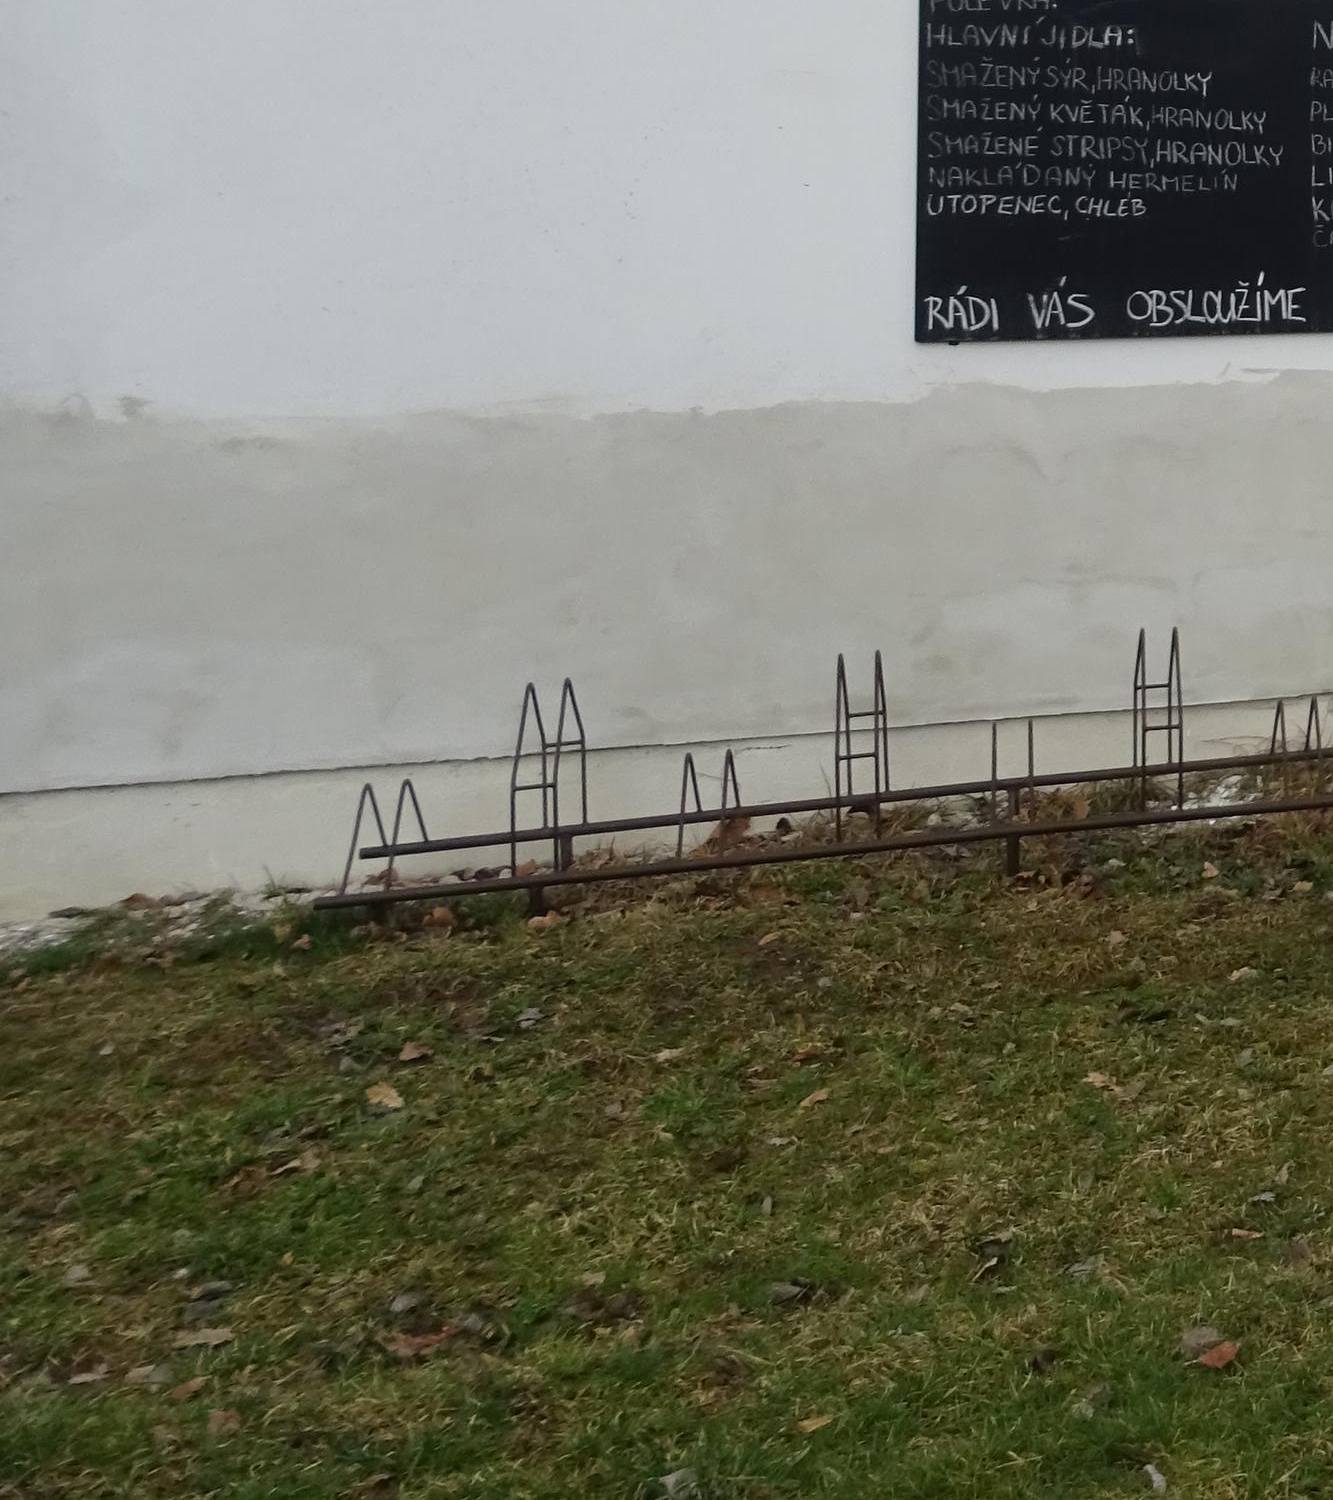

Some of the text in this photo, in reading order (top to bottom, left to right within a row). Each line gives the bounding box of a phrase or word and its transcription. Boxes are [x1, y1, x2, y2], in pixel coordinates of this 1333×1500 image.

[924, 284, 999, 331] RÁDI
[1026, 274, 1097, 330] VÁS
[1126, 270, 1307, 328] OBSLOUŽÍME
